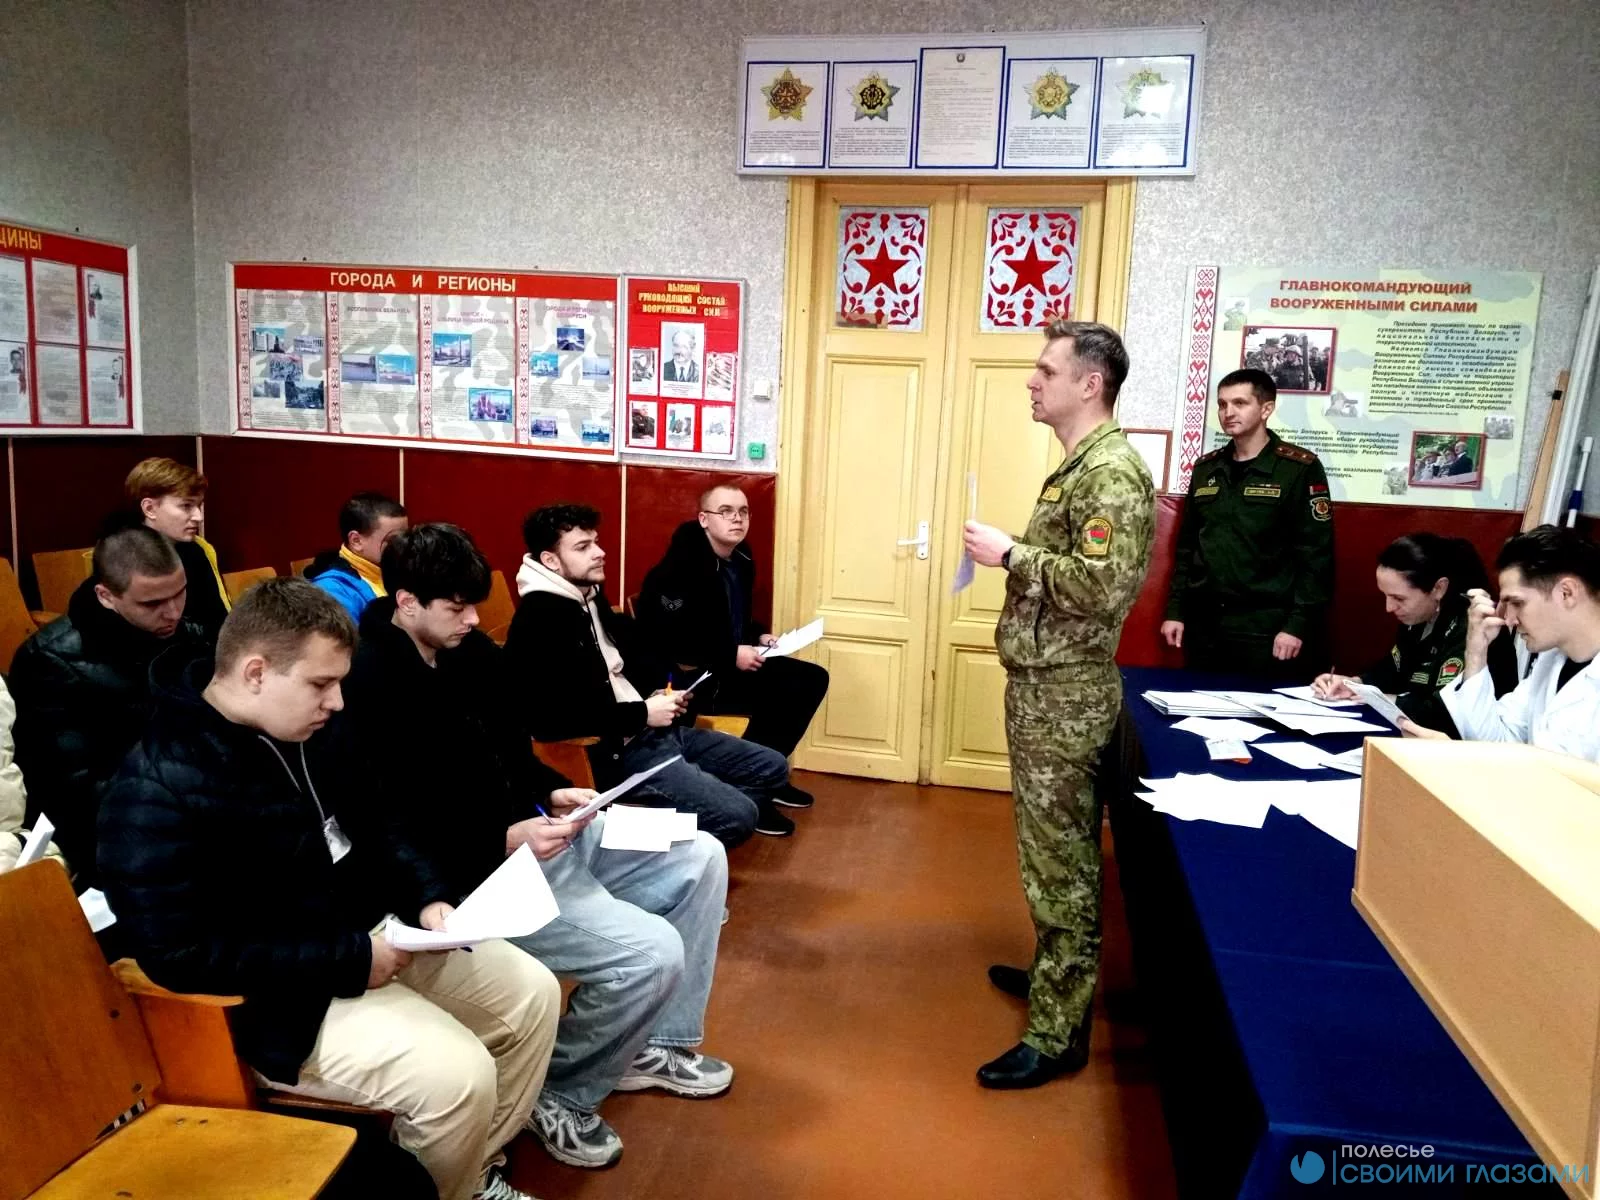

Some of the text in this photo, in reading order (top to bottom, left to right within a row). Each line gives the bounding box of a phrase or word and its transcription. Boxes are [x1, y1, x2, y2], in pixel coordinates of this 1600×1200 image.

[330, 272, 516, 292] ГОРОДА И РЕГИОНЫ
[668, 282, 700, 293] ВЫСШИЙ
[1280, 280, 1472, 296] ГЛАВНОКОМАНДУЮЩИЙ
[638, 292, 726, 306] РУКОВОДЯЩИЙ СОСТАВ
[642, 304, 696, 314] ВООРУЖЕННЫХ
[1270, 298, 1478, 313] ВООРУЖЕННЫМИ СИЛАМИ
[1434, 346, 1518, 355] Главнокомандующим
[1336, 430, 1400, 438] Главнокомандующий
